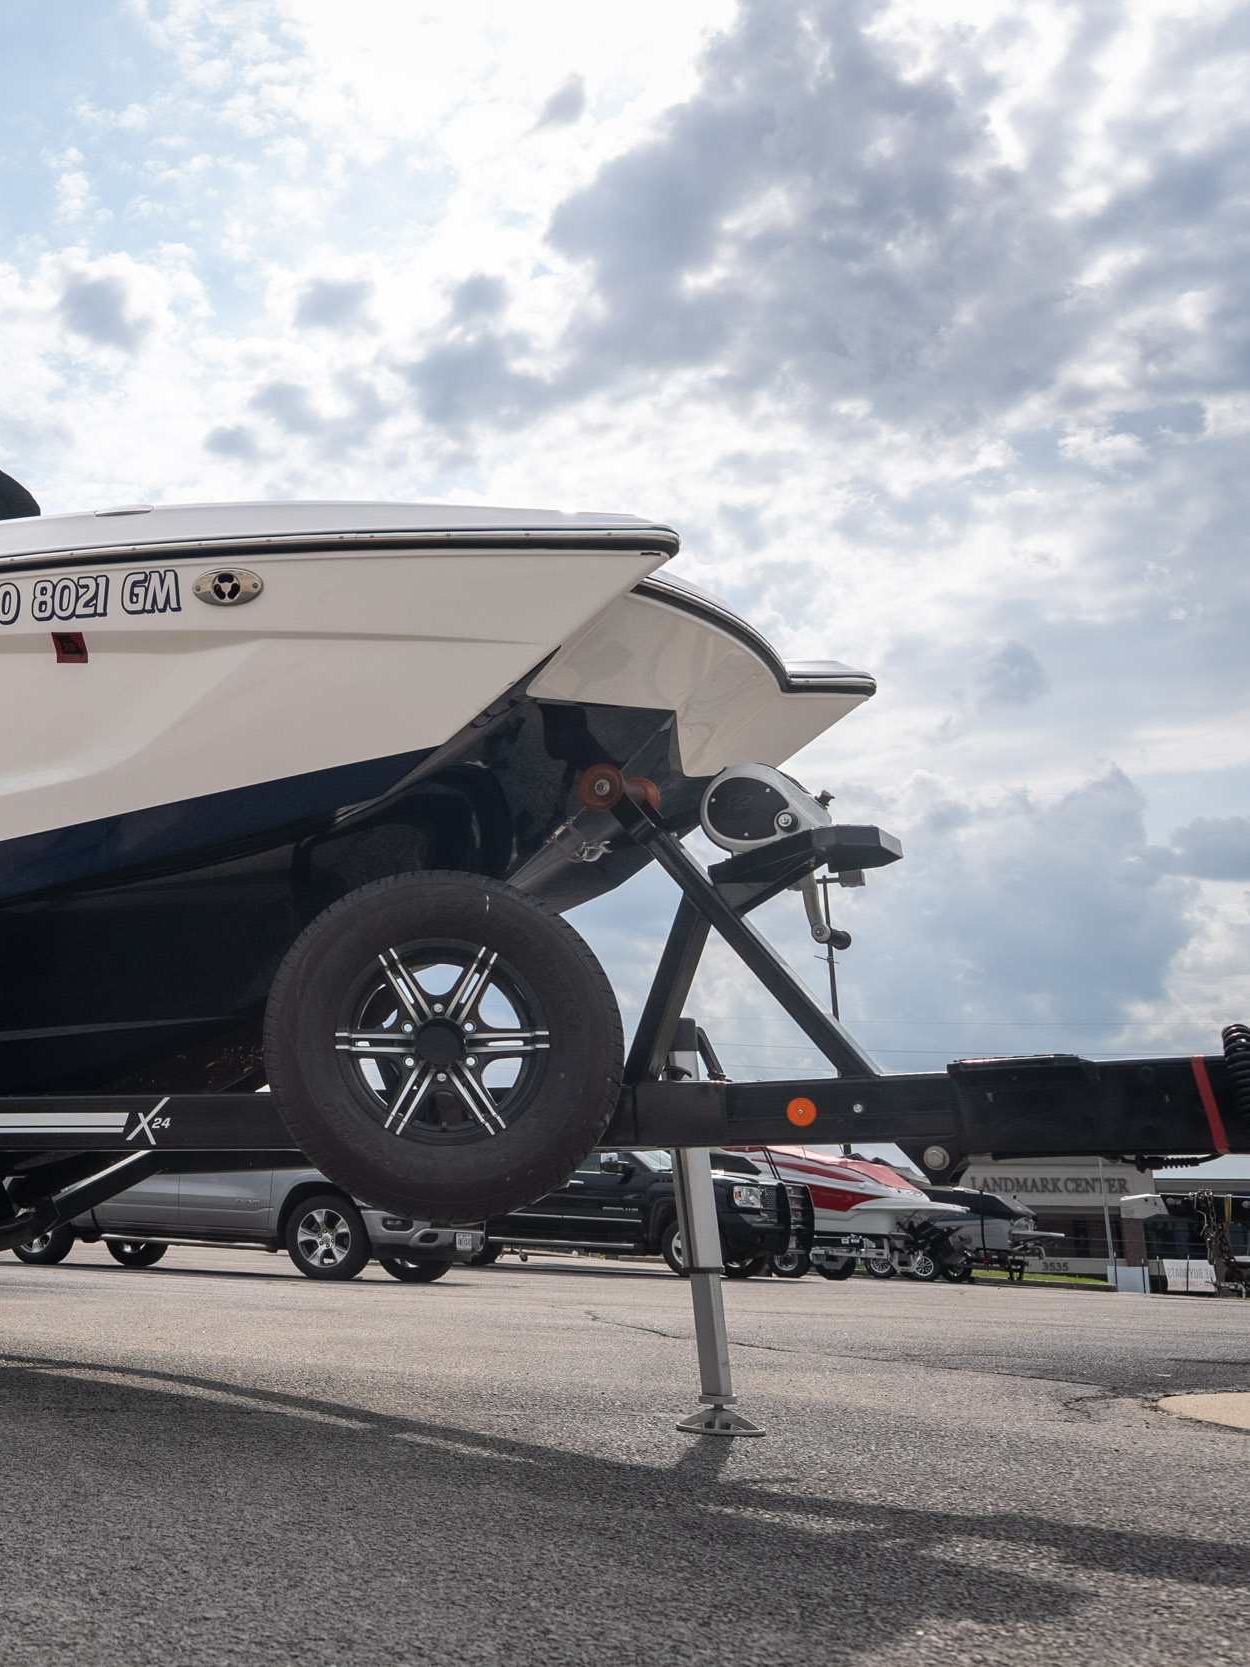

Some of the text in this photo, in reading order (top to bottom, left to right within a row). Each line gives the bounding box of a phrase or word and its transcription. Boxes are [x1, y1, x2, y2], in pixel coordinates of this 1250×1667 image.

[31, 575, 109, 622] 8021
[121, 569, 182, 616] GM
[970, 1176, 1130, 1194] LANDMARK CENTER
[1042, 1260, 1069, 1272] 3535
